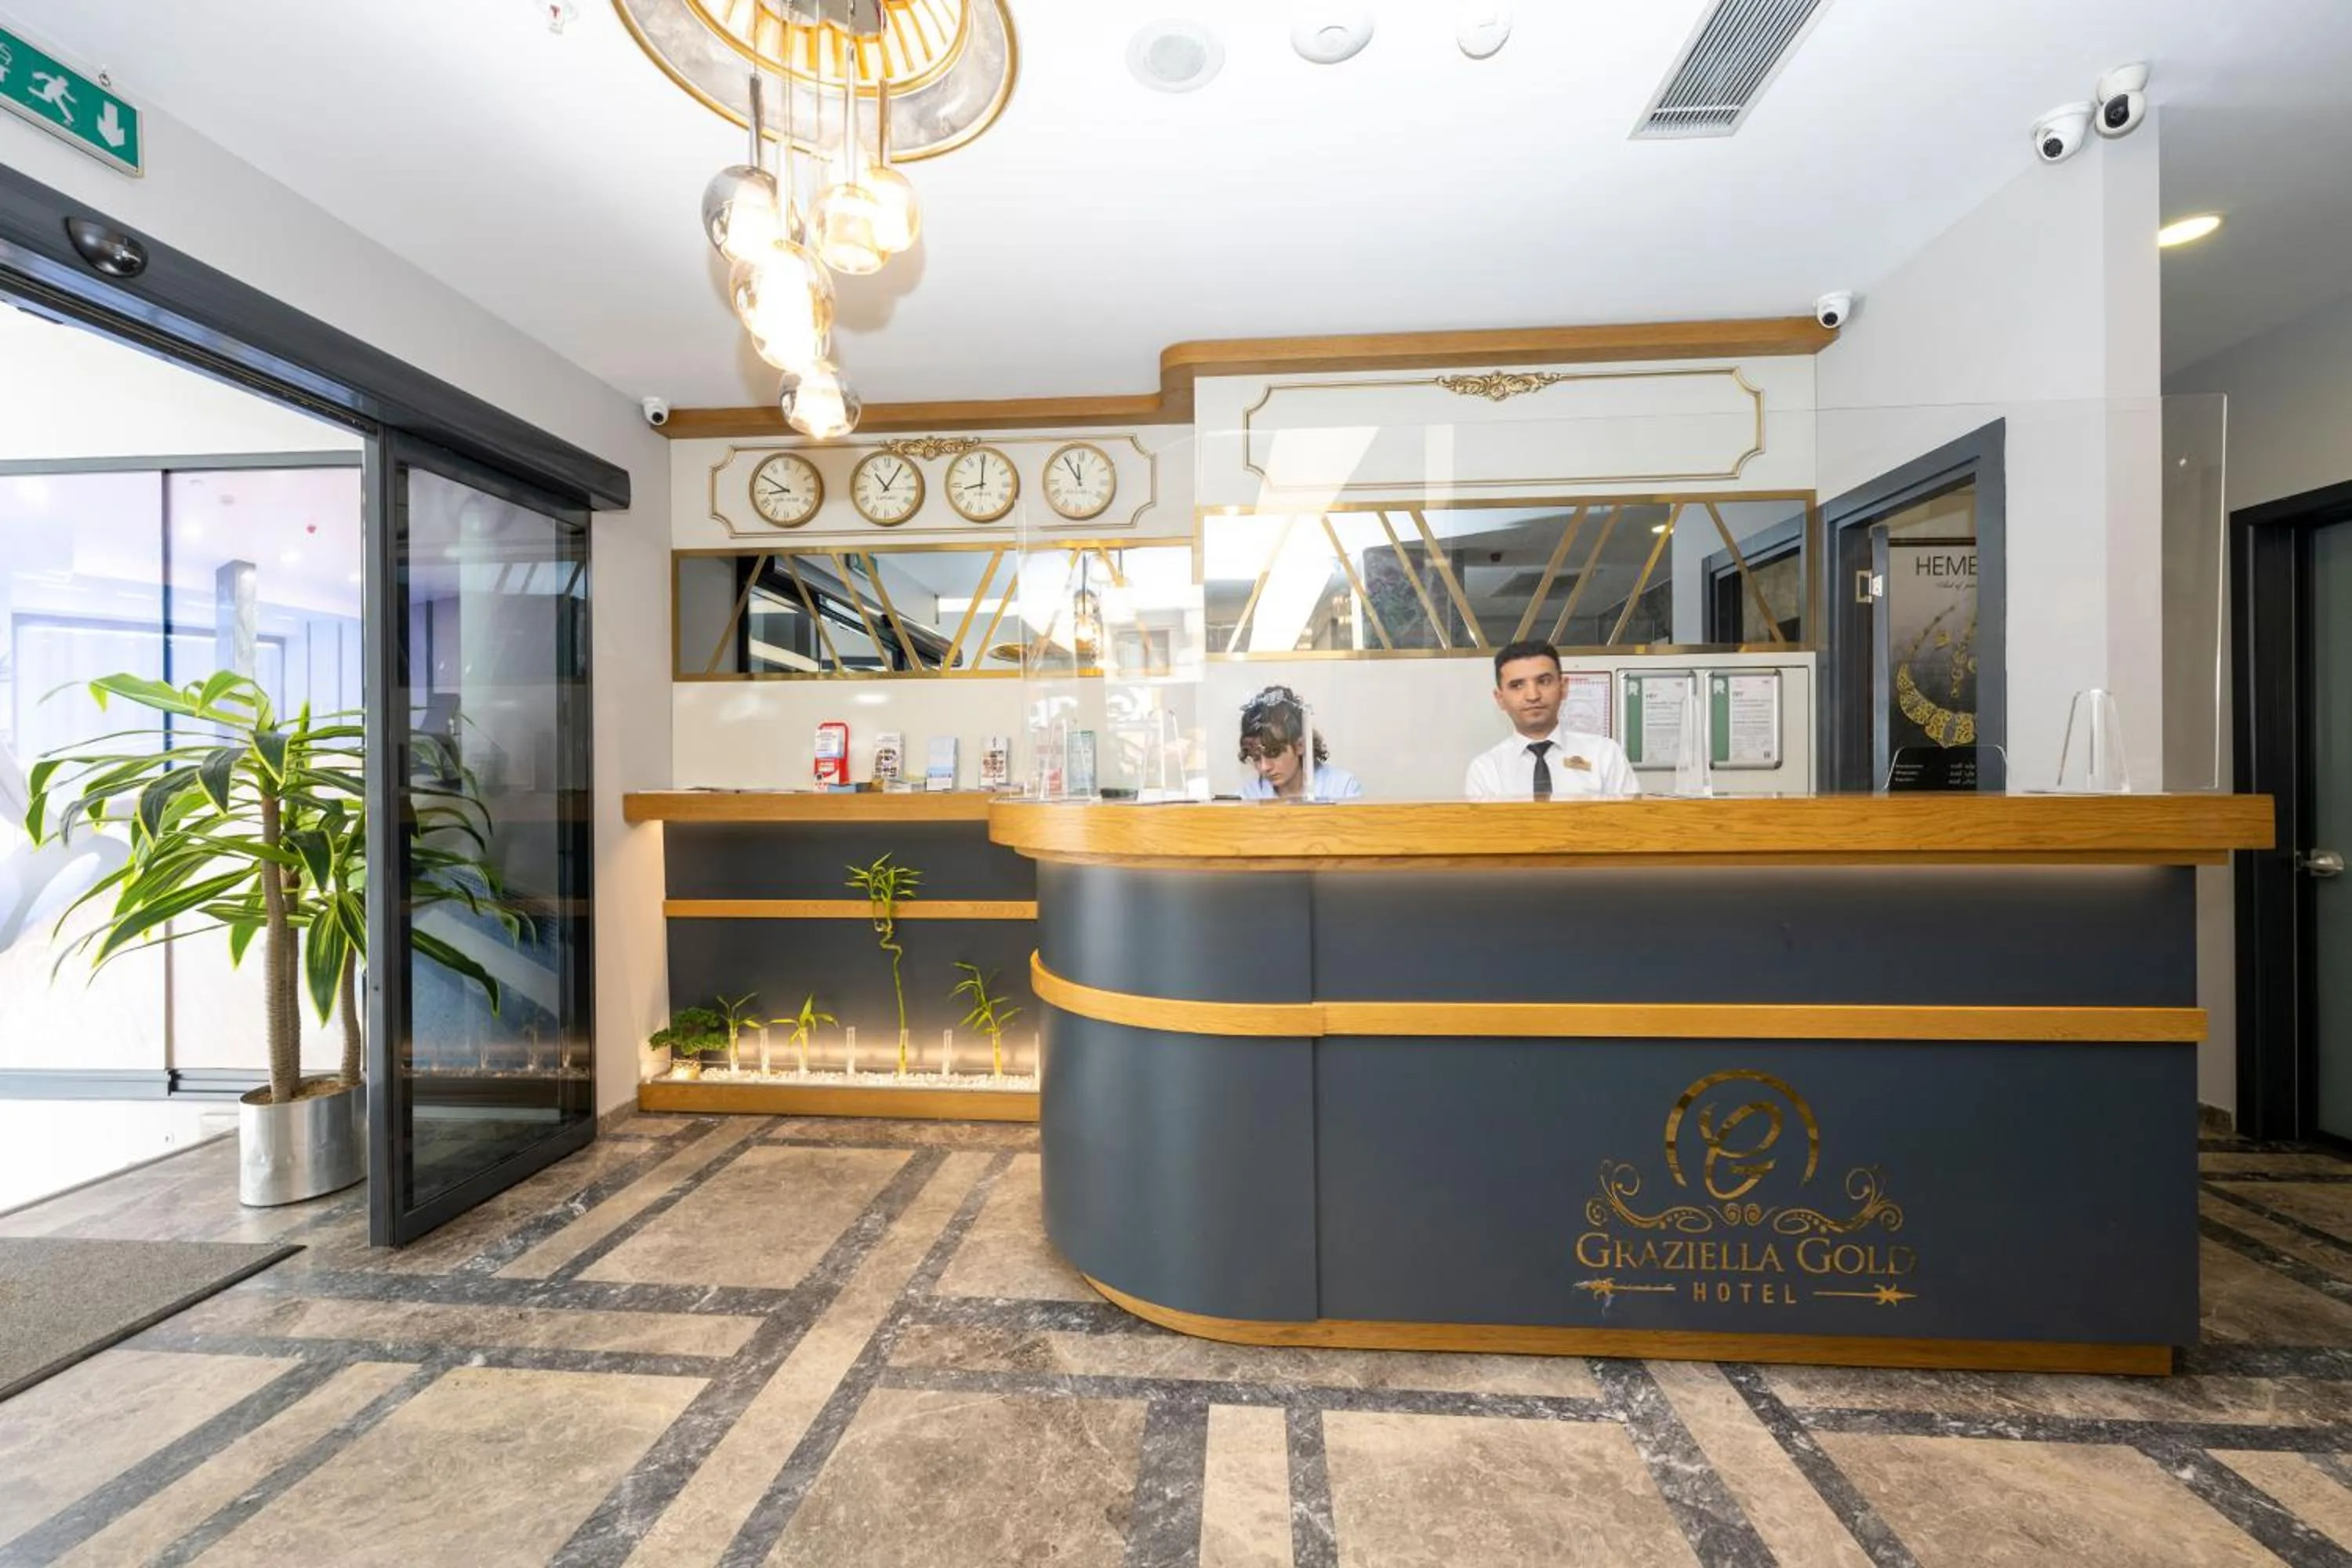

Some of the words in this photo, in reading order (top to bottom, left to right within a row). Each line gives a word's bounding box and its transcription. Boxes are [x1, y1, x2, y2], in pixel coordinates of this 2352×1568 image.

[1576, 1232, 1784, 1272] GRAZIELLA
[1796, 1237, 1917, 1275] GOLD
[1693, 1281, 1797, 1305] HOTEL
